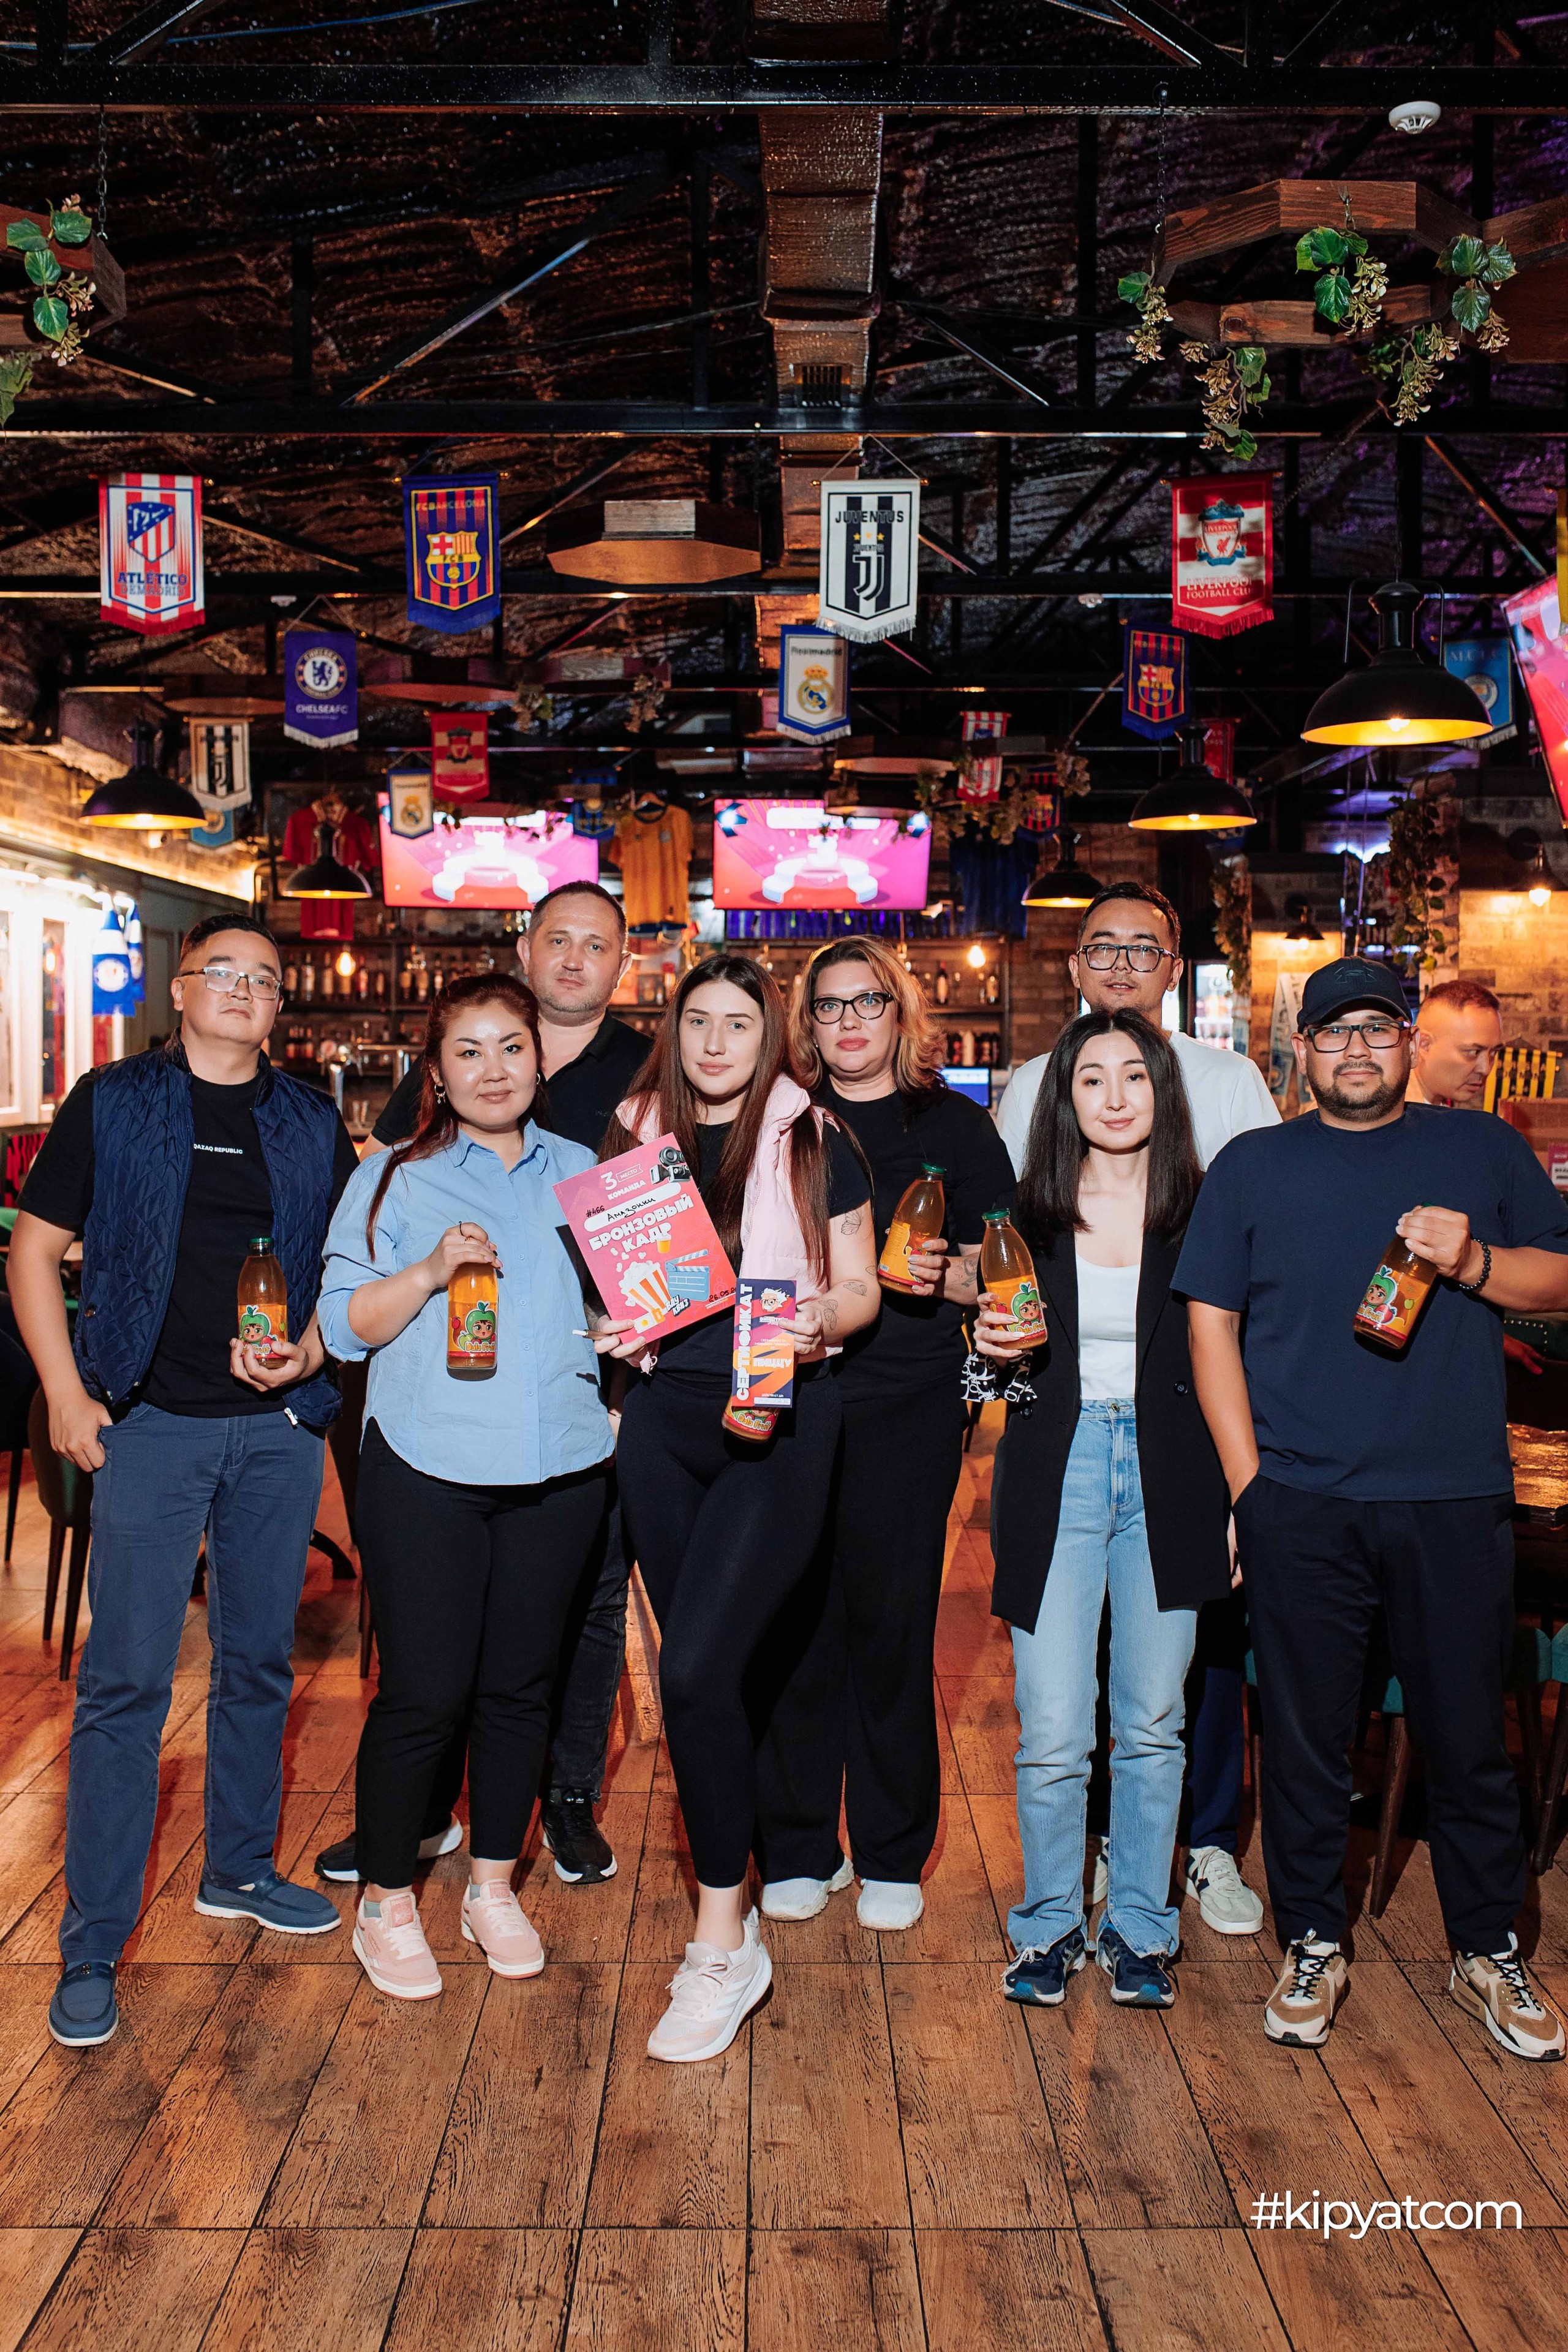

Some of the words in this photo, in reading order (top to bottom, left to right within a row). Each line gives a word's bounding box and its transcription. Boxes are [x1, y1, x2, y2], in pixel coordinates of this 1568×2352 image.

[835, 510, 904, 524] JUVENTUS
[117, 570, 187, 585] ATLÉTICO
[1186, 589, 1229, 599] FOOTBALL
[194, 1144, 213, 1152] QAZAQ
[600, 1170, 617, 1191] 3
[620, 1169, 638, 1179] МЕСТО
[608, 1180, 646, 1200] КОМАНДА
[586, 1205, 605, 1218] #466
[588, 1193, 695, 1251] БРОНЗОВЫЙ
[622, 1222, 671, 1253] КАДР
[709, 1287, 736, 1302] 26.05.2
[736, 1283, 753, 1401] СЕРТИФИКАТ
